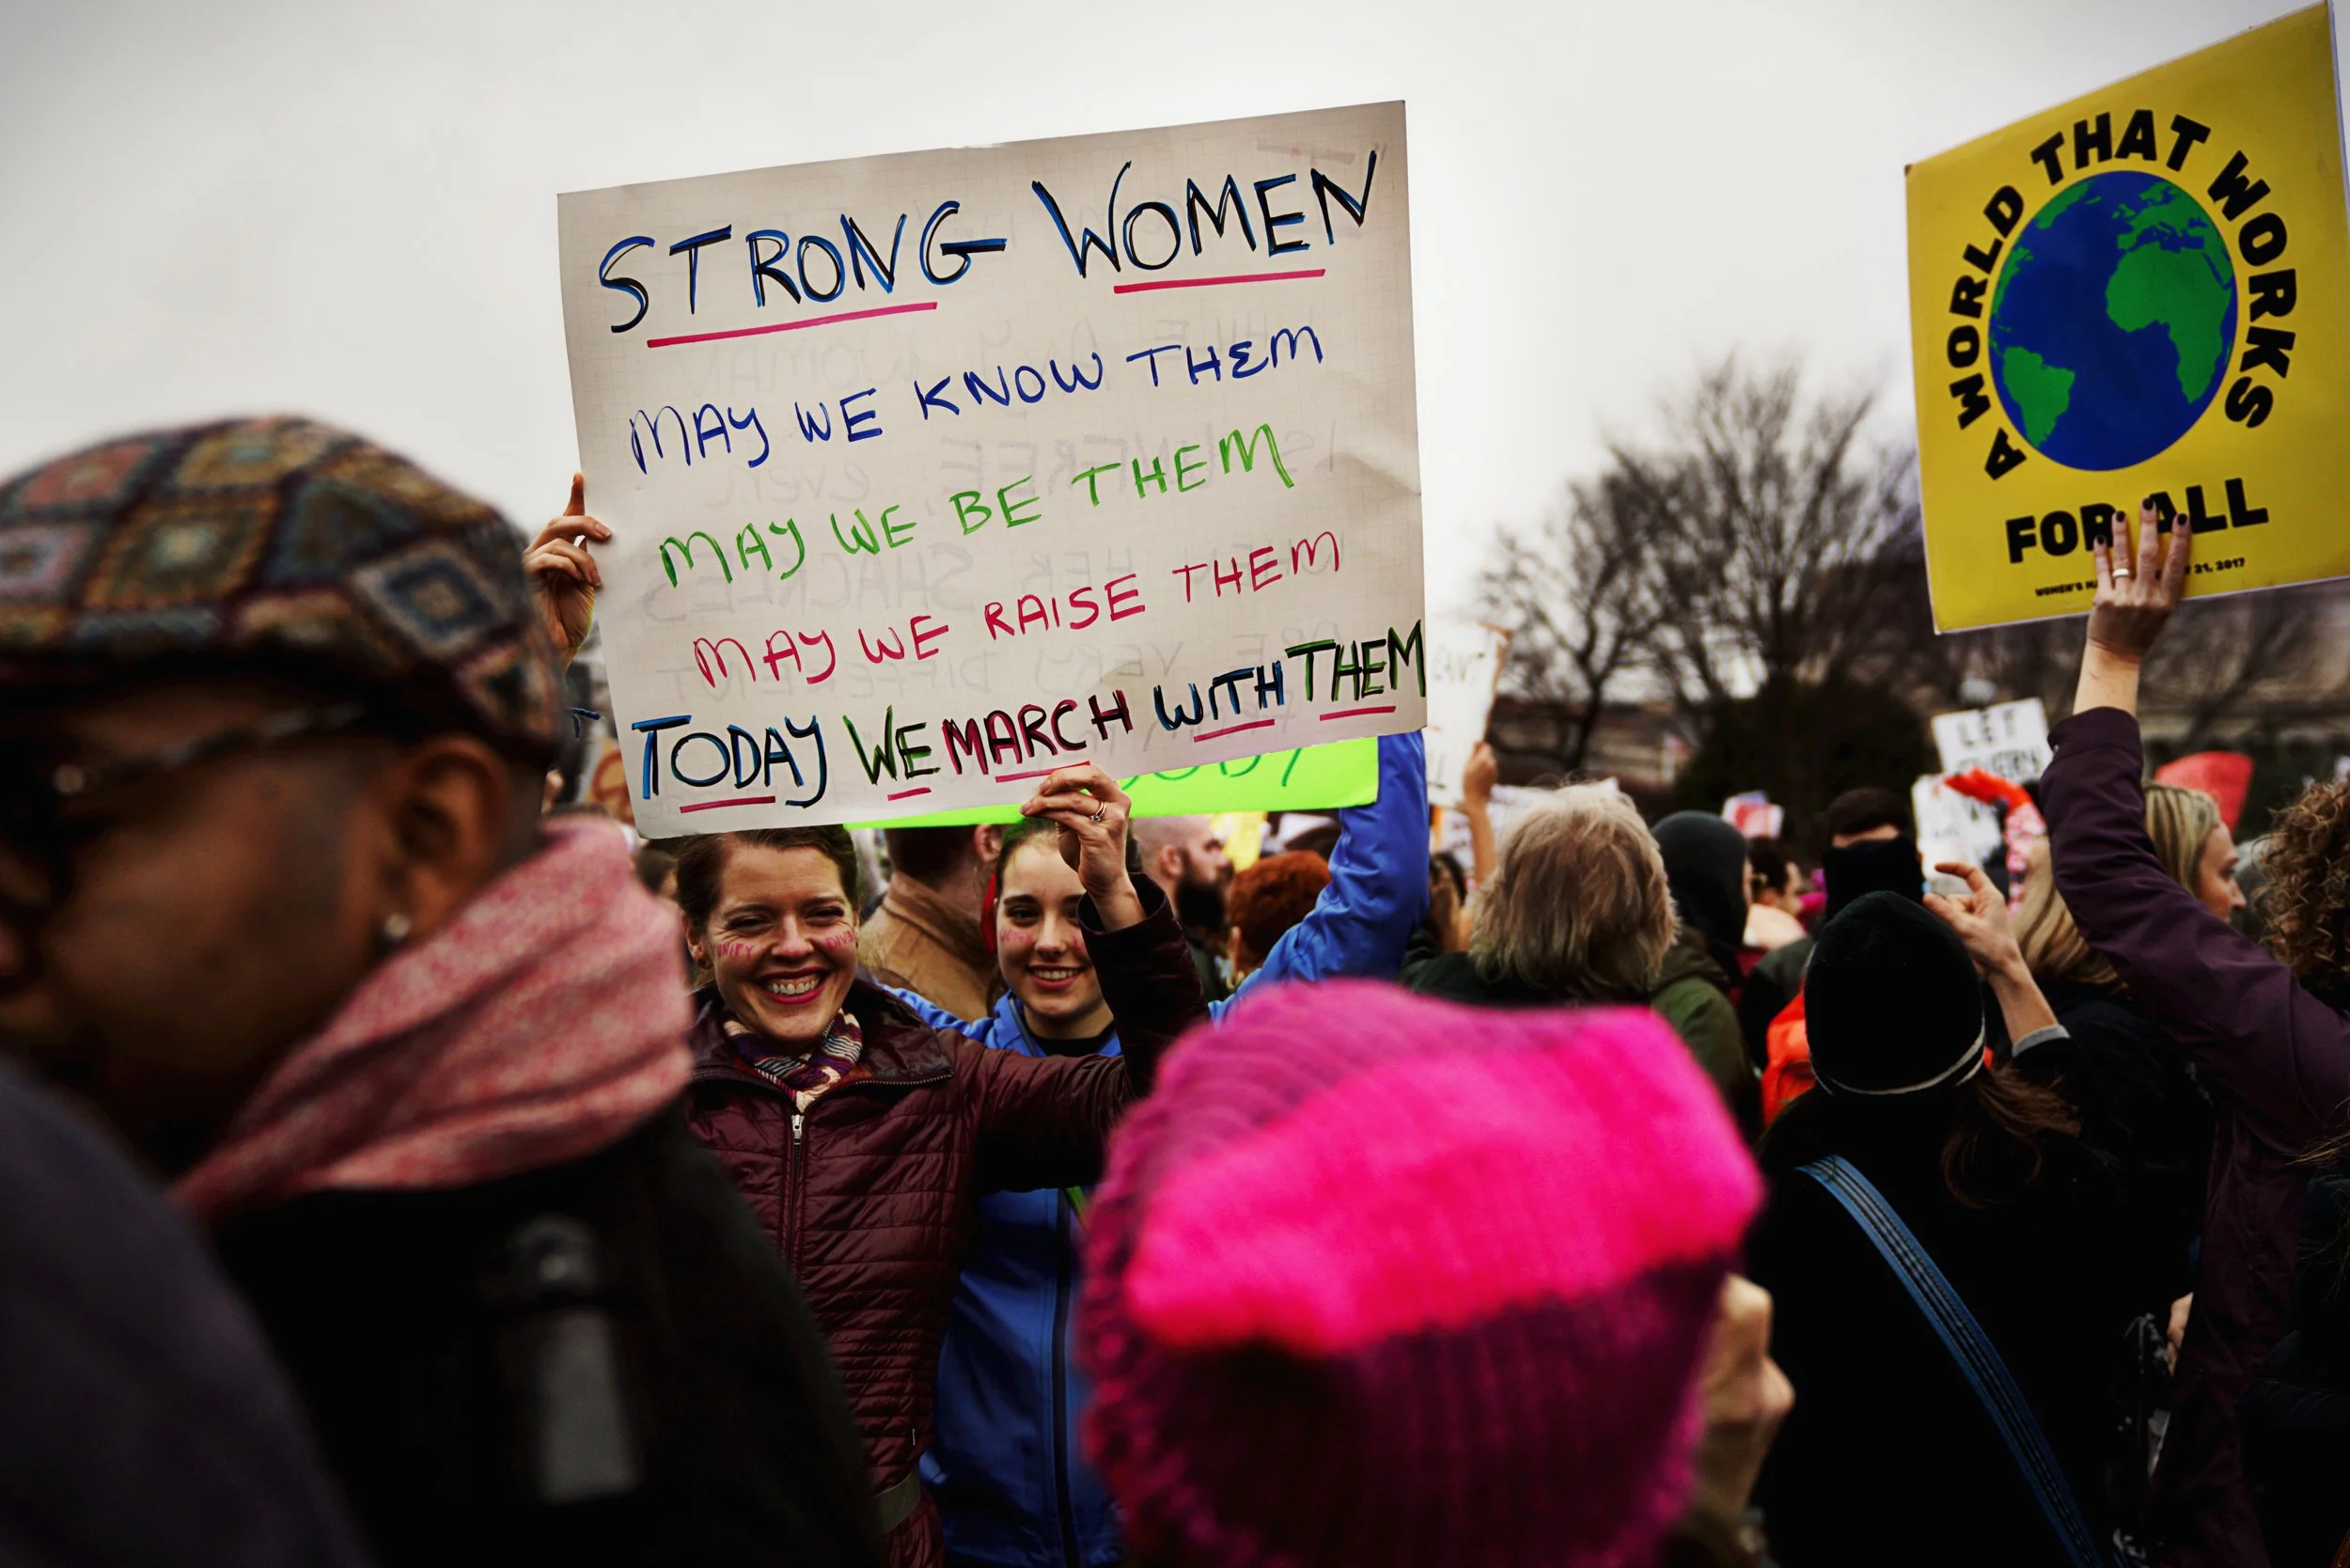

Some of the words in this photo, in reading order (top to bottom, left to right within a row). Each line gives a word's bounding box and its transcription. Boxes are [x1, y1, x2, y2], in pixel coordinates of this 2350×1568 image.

[2030, 109, 2211, 185] THAT
[599, 200, 1007, 333] STRONG
[1032, 150, 1377, 278] WOMEN
[1947, 185, 2024, 430] WORLD
[2207, 150, 2296, 429] WORKS
[630, 403, 769, 474] MAY
[795, 387, 884, 442] WE
[915, 353, 1104, 420] KNOW
[1125, 326, 1323, 386] THEM
[1984, 428, 2027, 480] A
[659, 518, 806, 588] MAY
[830, 505, 916, 555] WE
[948, 476, 1042, 536] BE
[1072, 424, 1294, 507] THEM
[2005, 503, 2117, 564] FOR
[2149, 478, 2269, 534] ALL
[2035, 582, 2083, 597] WOMEN'S
[2216, 557, 2246, 571] 2017
[693, 630, 836, 687] MAY
[859, 616, 948, 665] WE
[984, 573, 1146, 640] RAISE
[1172, 531, 1340, 603] THEM
[631, 714, 827, 808] TODAY
[843, 704, 941, 786] WE
[942, 688, 1134, 776] MARCH
[1153, 661, 1284, 730] WITH
[1285, 619, 1426, 702] THEM
